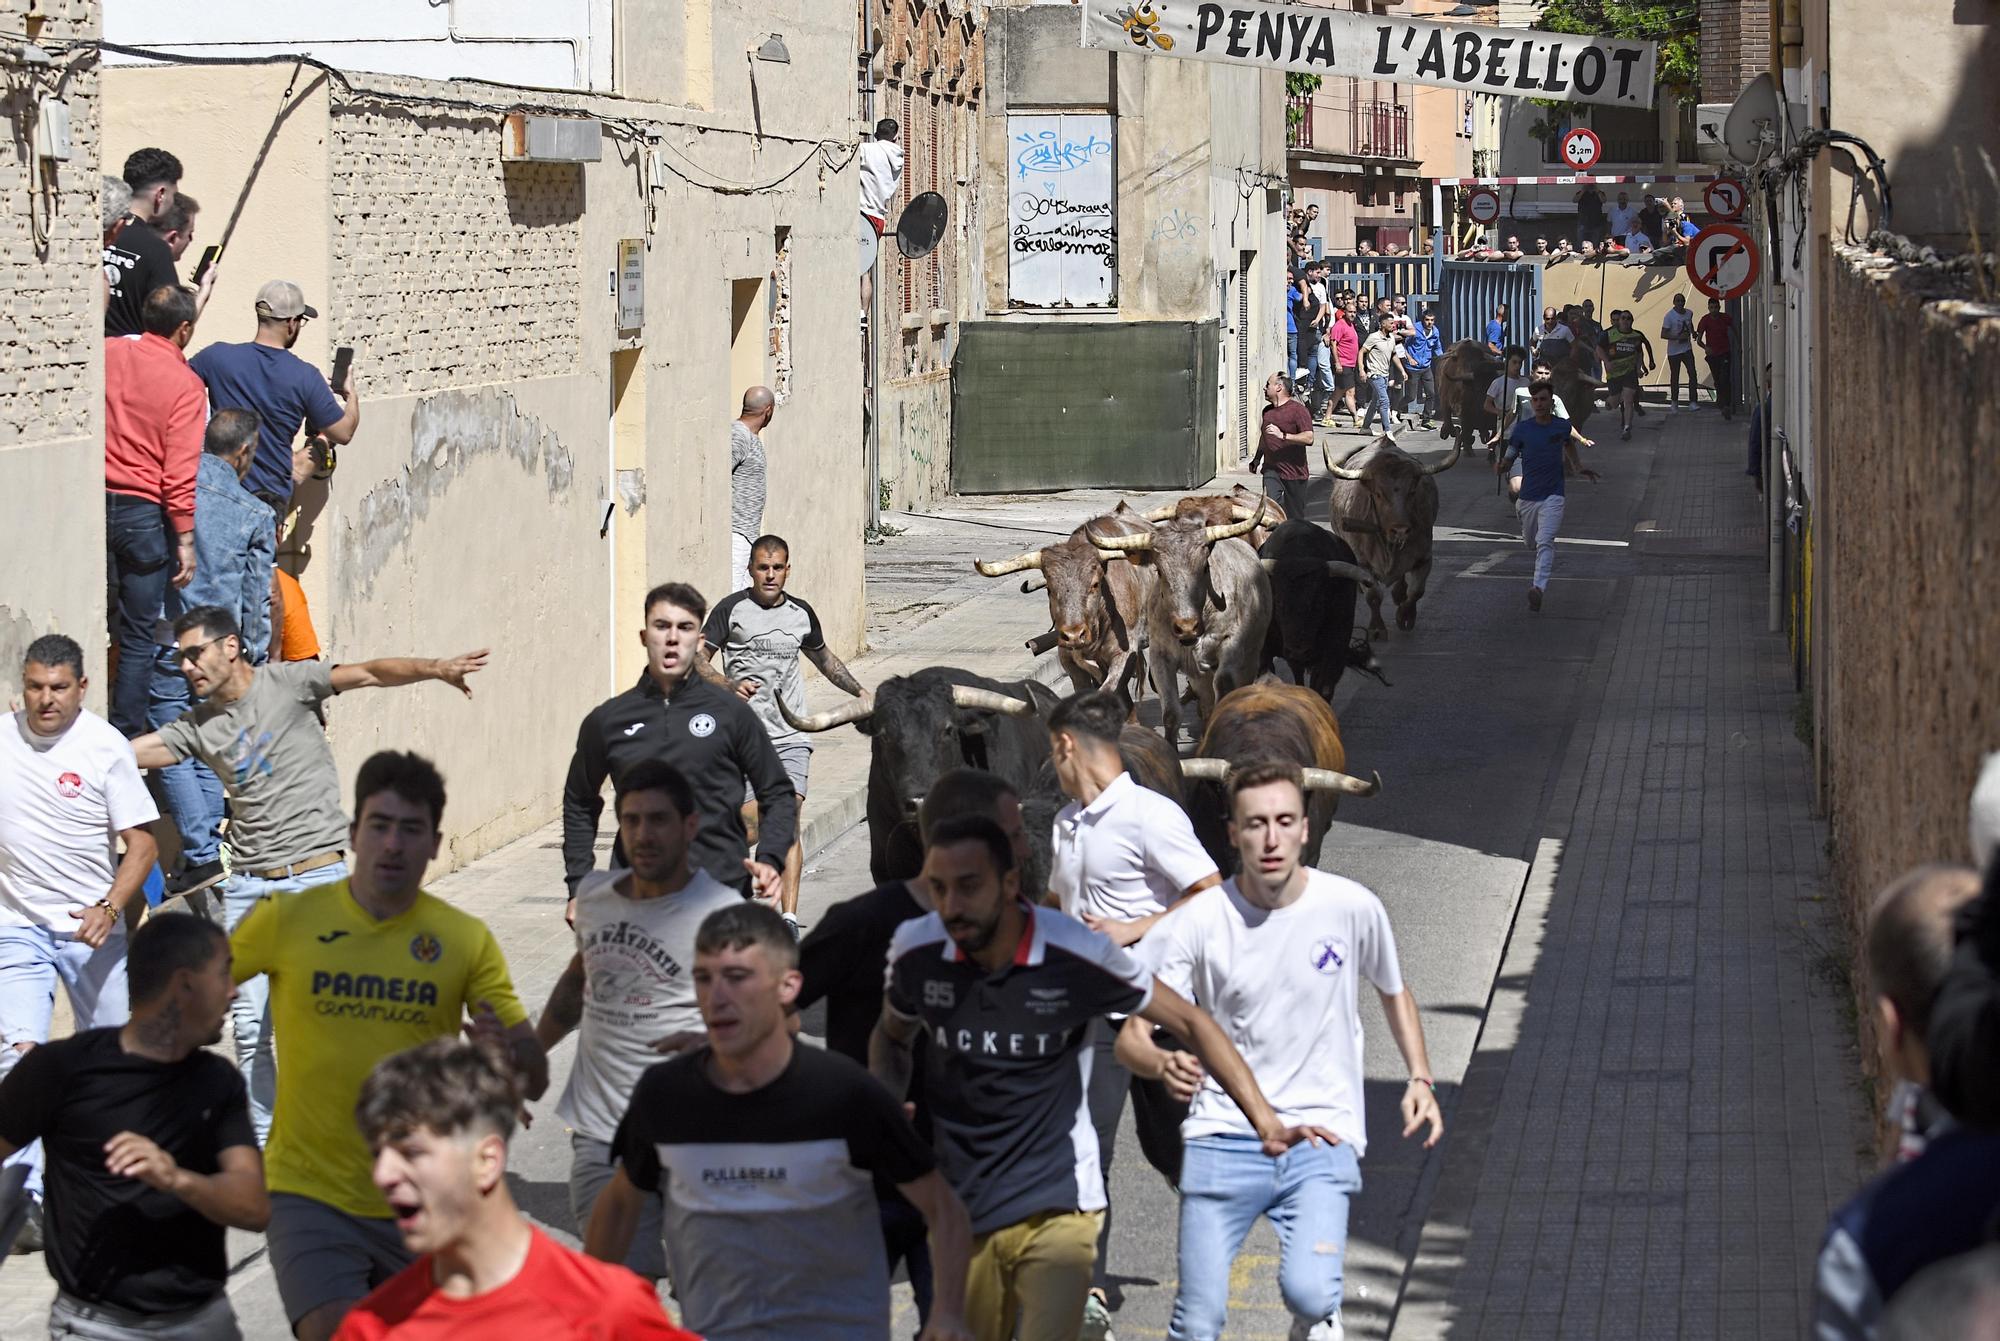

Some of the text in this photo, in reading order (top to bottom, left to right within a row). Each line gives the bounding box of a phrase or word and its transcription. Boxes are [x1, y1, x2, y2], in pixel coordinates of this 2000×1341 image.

[1195, 3, 1643, 98] PENYA L'ABELLOT
[311, 970, 438, 1007] PAMESA
